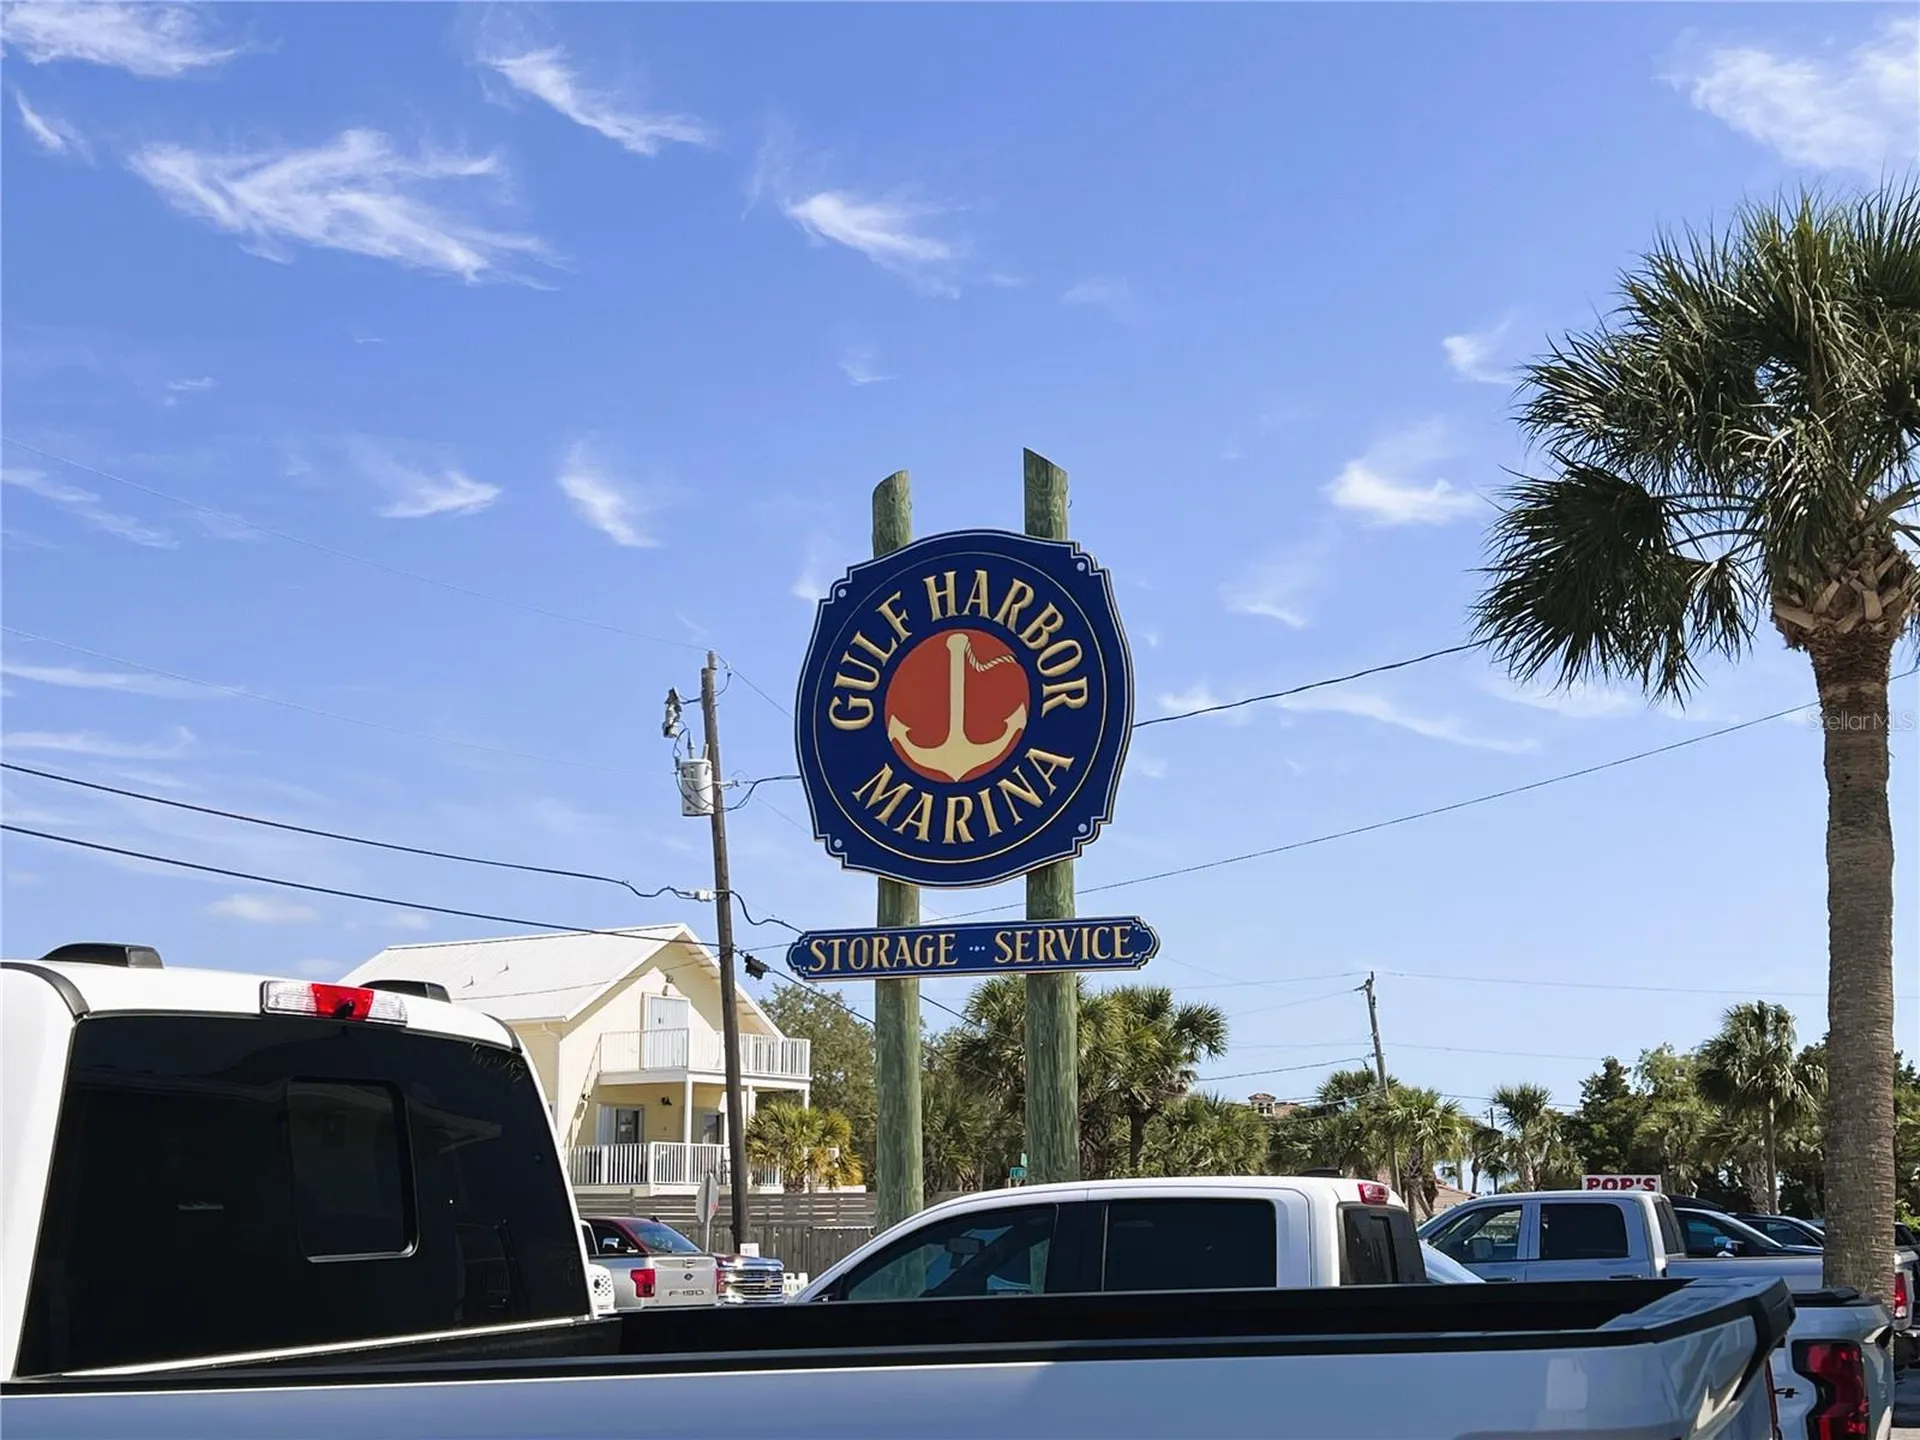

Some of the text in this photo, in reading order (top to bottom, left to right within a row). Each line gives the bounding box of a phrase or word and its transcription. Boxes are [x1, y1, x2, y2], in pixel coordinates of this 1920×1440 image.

[828, 569, 1089, 731] GULF HARBOR
[852, 747, 1075, 845] MARINA
[807, 925, 1135, 972] STORAGE SERVICE
[1586, 1177, 1657, 1192] POP'S
